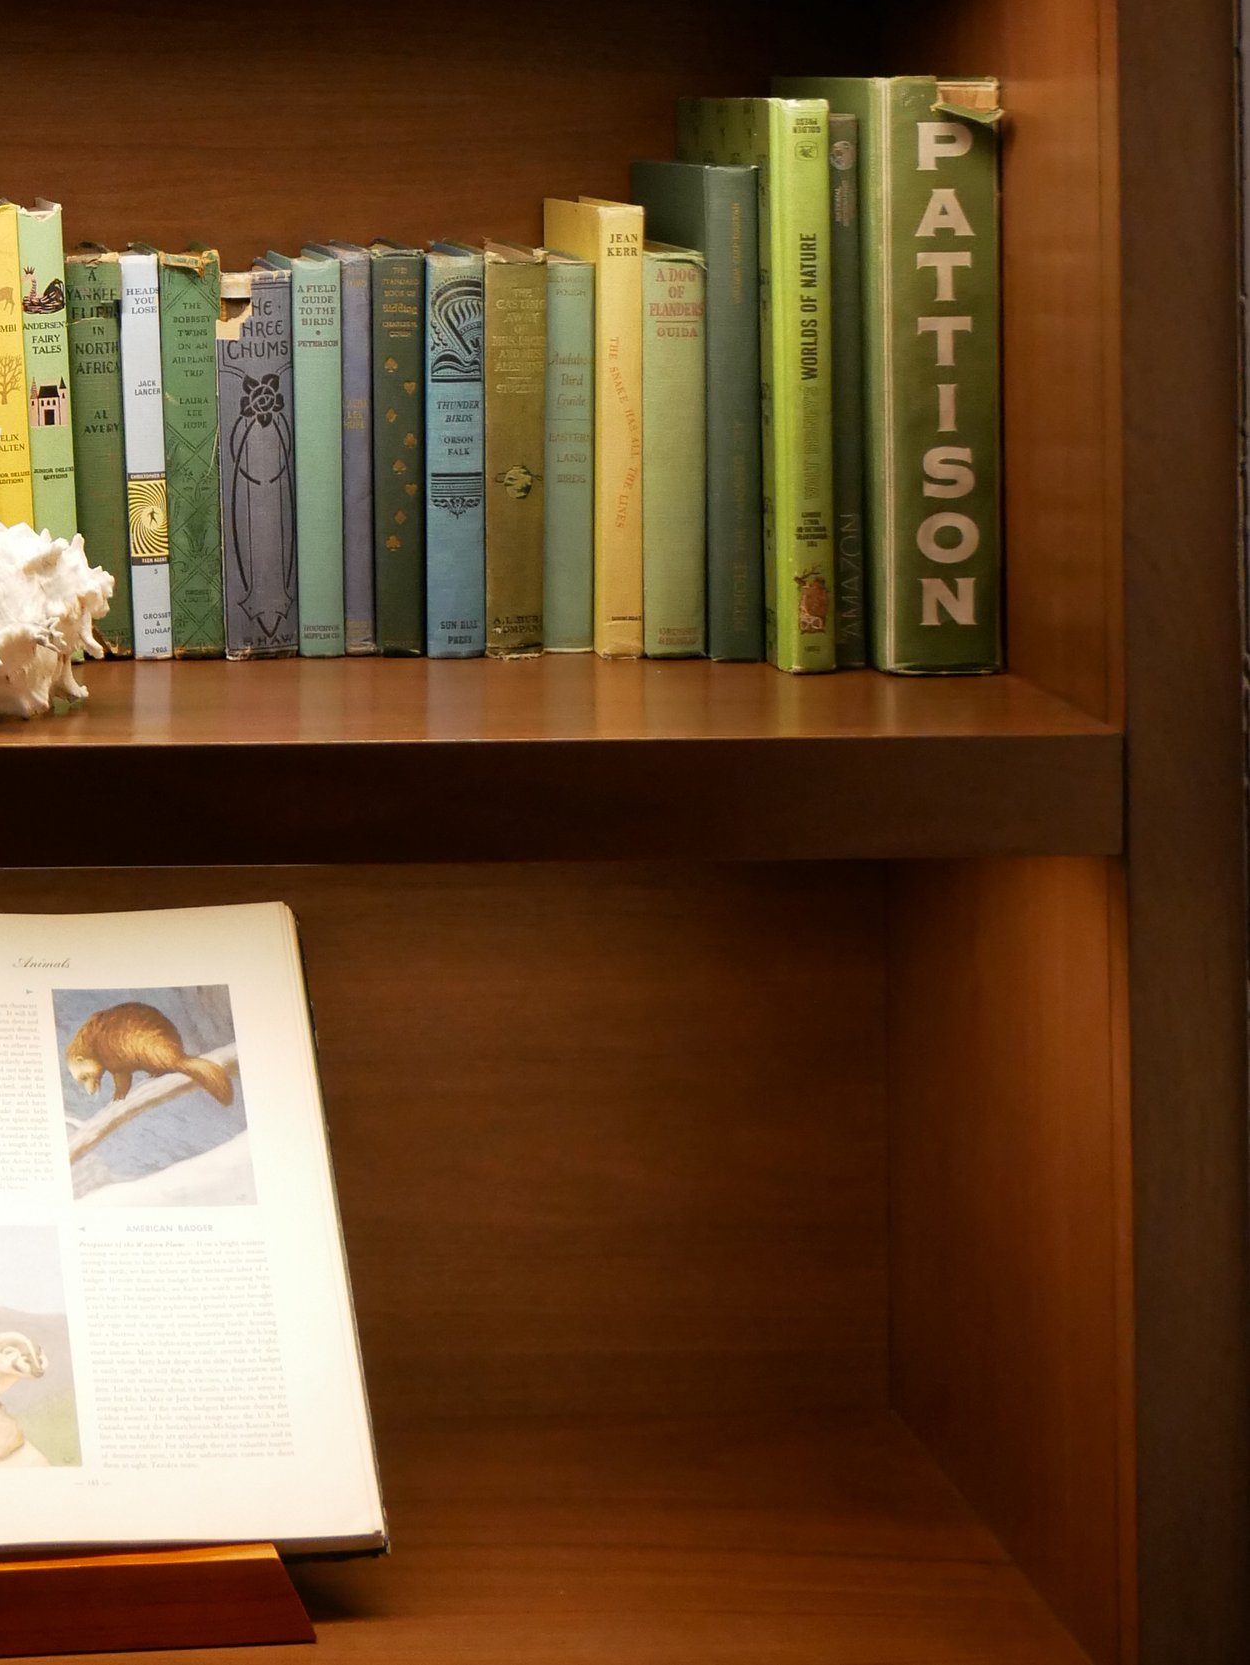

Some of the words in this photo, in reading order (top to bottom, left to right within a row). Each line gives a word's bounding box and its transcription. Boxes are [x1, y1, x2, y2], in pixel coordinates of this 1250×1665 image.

[610, 233, 638, 243] JEAN
[607, 247, 638, 257] KERR
[799, 233, 817, 284] NATURE
[656, 269, 665, 281] A
[669, 268, 696, 282] DOG
[126, 287, 158, 297] HEADS
[306, 285, 336, 293] FIELD
[135, 297, 154, 305] YOU
[302, 296, 333, 304] GUIDE
[801, 290, 817, 311] OF
[131, 306, 158, 314] LOSE
[302, 318, 334, 326] BIRDS
[32, 334, 60, 344] FAIRY
[298, 340, 338, 348] PETERSON
[32, 344, 62, 354] TALES
[227, 340, 288, 360] CHUMS
[800, 317, 819, 381] WORLDS
[916, 120, 980, 626] PATTISON
[437, 400, 479, 410] THUNDER
[446, 414, 472, 423] BIRDS
[13, 957, 71, 969] Animals
[178, 1224, 213, 1232] BADGER
